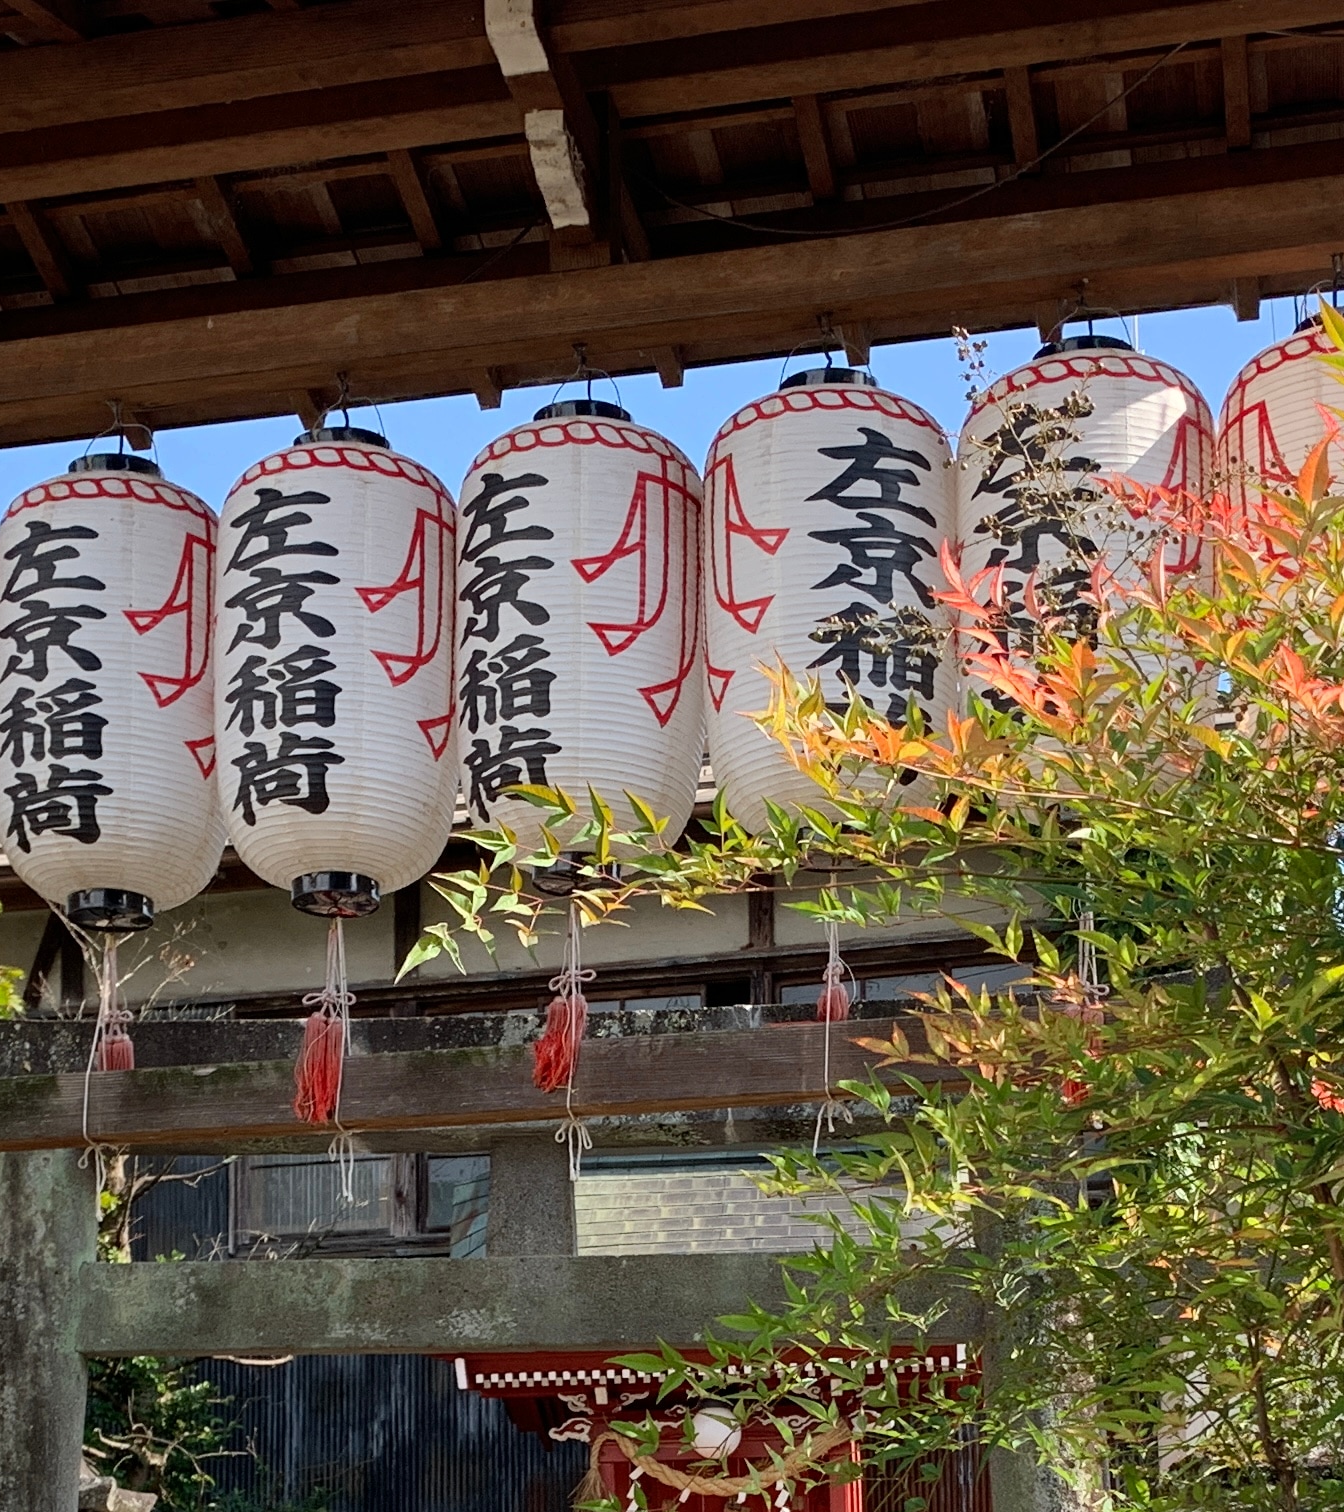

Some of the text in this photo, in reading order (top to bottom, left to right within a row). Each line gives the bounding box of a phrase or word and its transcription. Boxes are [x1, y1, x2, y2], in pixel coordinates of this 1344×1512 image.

[223, 488, 345, 827] 左京稲荷
[459, 472, 561, 824] 左京稲荷
[804, 427, 940, 786] 左京稲
